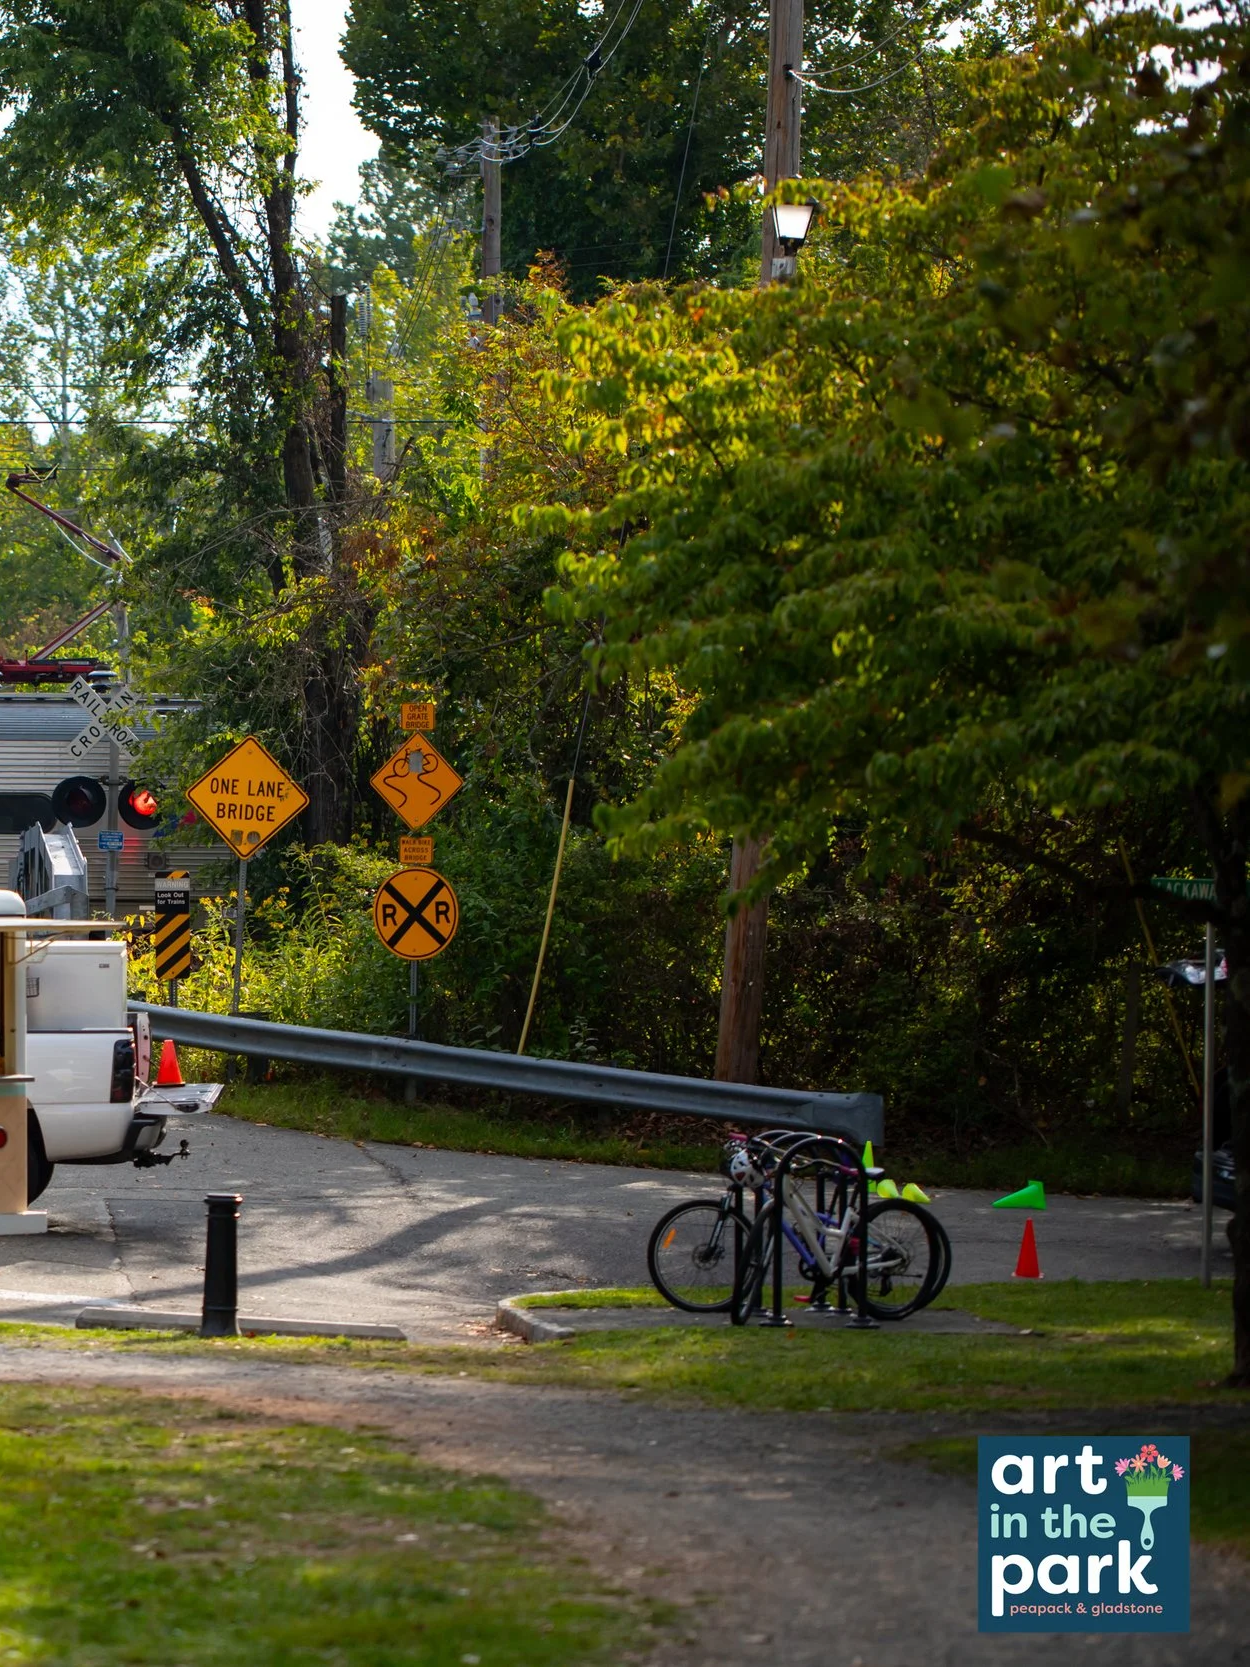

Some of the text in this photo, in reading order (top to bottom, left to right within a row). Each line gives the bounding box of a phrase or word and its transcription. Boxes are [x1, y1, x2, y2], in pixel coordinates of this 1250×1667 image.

[408, 704, 428, 712] OPEN
[407, 712, 429, 720] GRATE
[405, 721, 430, 729] BRIDGE
[210, 777, 285, 798] ONE LANE
[216, 802, 276, 822] BRIDGE
[156, 880, 189, 889] WARNING
[1156, 881, 1217, 900] ACKAWA
[382, 900, 451, 927] R R
